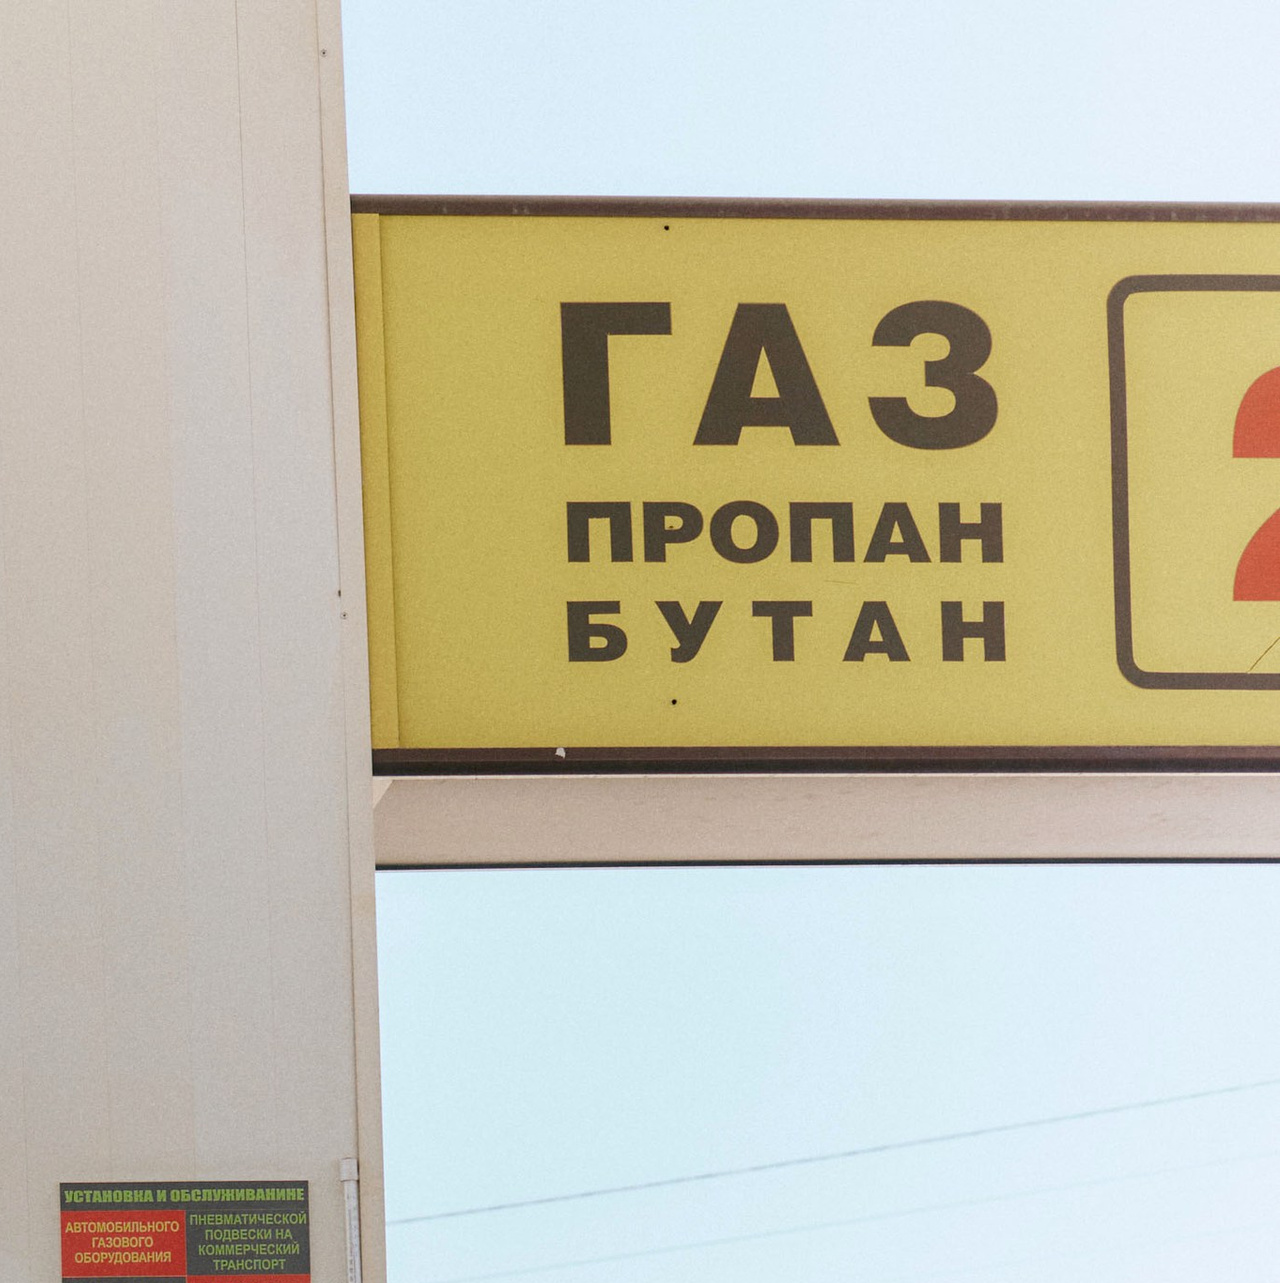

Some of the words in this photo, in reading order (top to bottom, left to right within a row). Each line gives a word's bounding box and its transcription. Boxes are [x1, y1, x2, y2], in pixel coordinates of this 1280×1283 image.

[559, 300, 999, 450] ГАЗ
[566, 501, 1004, 563] ПРОПАН
[566, 601, 1006, 662] БУТАН
[65, 1190, 154, 1203] УСТАНОВКА
[157, 1189, 167, 1202] И
[190, 1211, 307, 1226] ПНЕВМАТИЧЕСКОЙ
[65, 1222, 179, 1233] АВТОМОБИЛЬНОГО
[205, 1229, 272, 1241] ПОДВЕСКИ
[275, 1229, 292, 1239] НА
[92, 1237, 153, 1249] ГАЗОВОГО
[198, 1242, 299, 1255] КОММЕРЧЕСКИЙ
[75, 1252, 171, 1264] ОБОРУДОВАНИЯ
[213, 1259, 286, 1271] ТРАНСПОРТ
